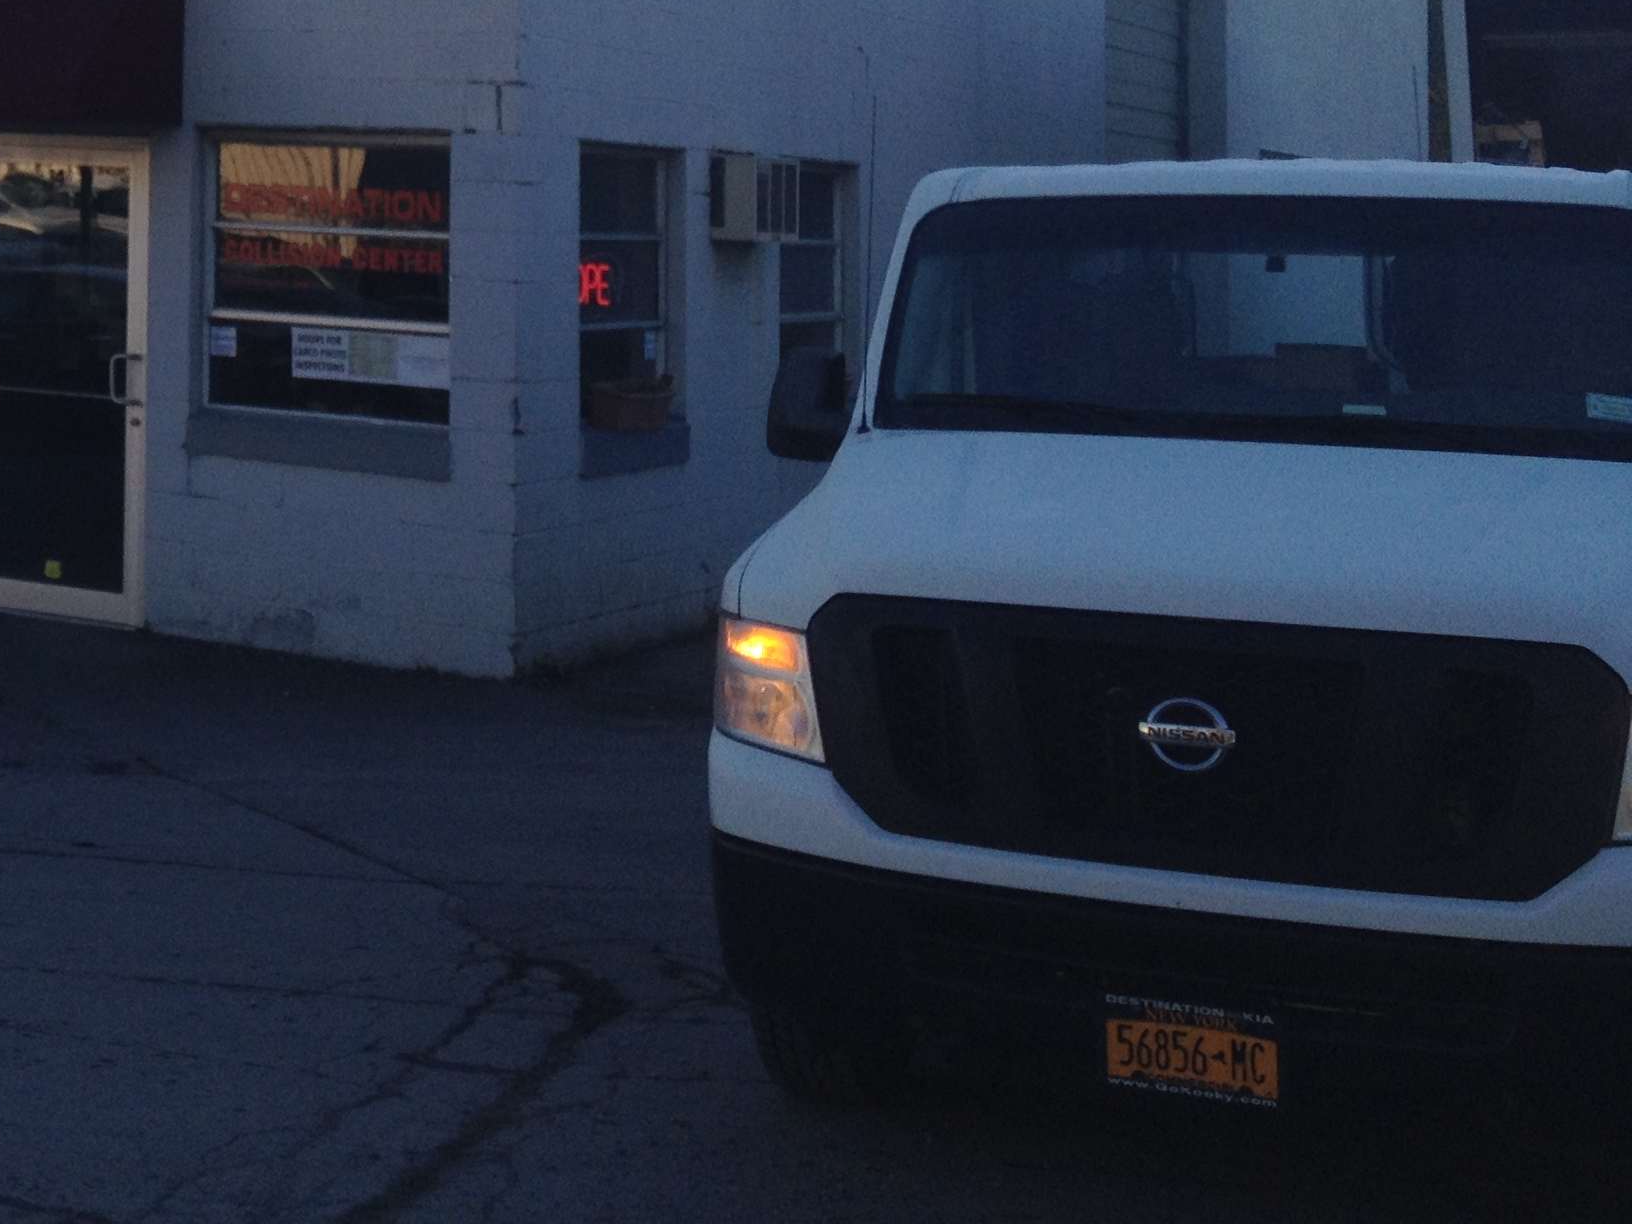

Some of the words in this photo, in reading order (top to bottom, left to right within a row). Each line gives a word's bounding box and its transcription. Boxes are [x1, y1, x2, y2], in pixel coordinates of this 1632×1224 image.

[223, 182, 443, 222] DESTINATION
[223, 238, 341, 268] COLLISION
[352, 244, 444, 274] CENTER
[1147, 725, 1225, 744] NISSAN
[1105, 993, 1225, 1017] DESTINATION
[1243, 1011, 1275, 1025] KIA
